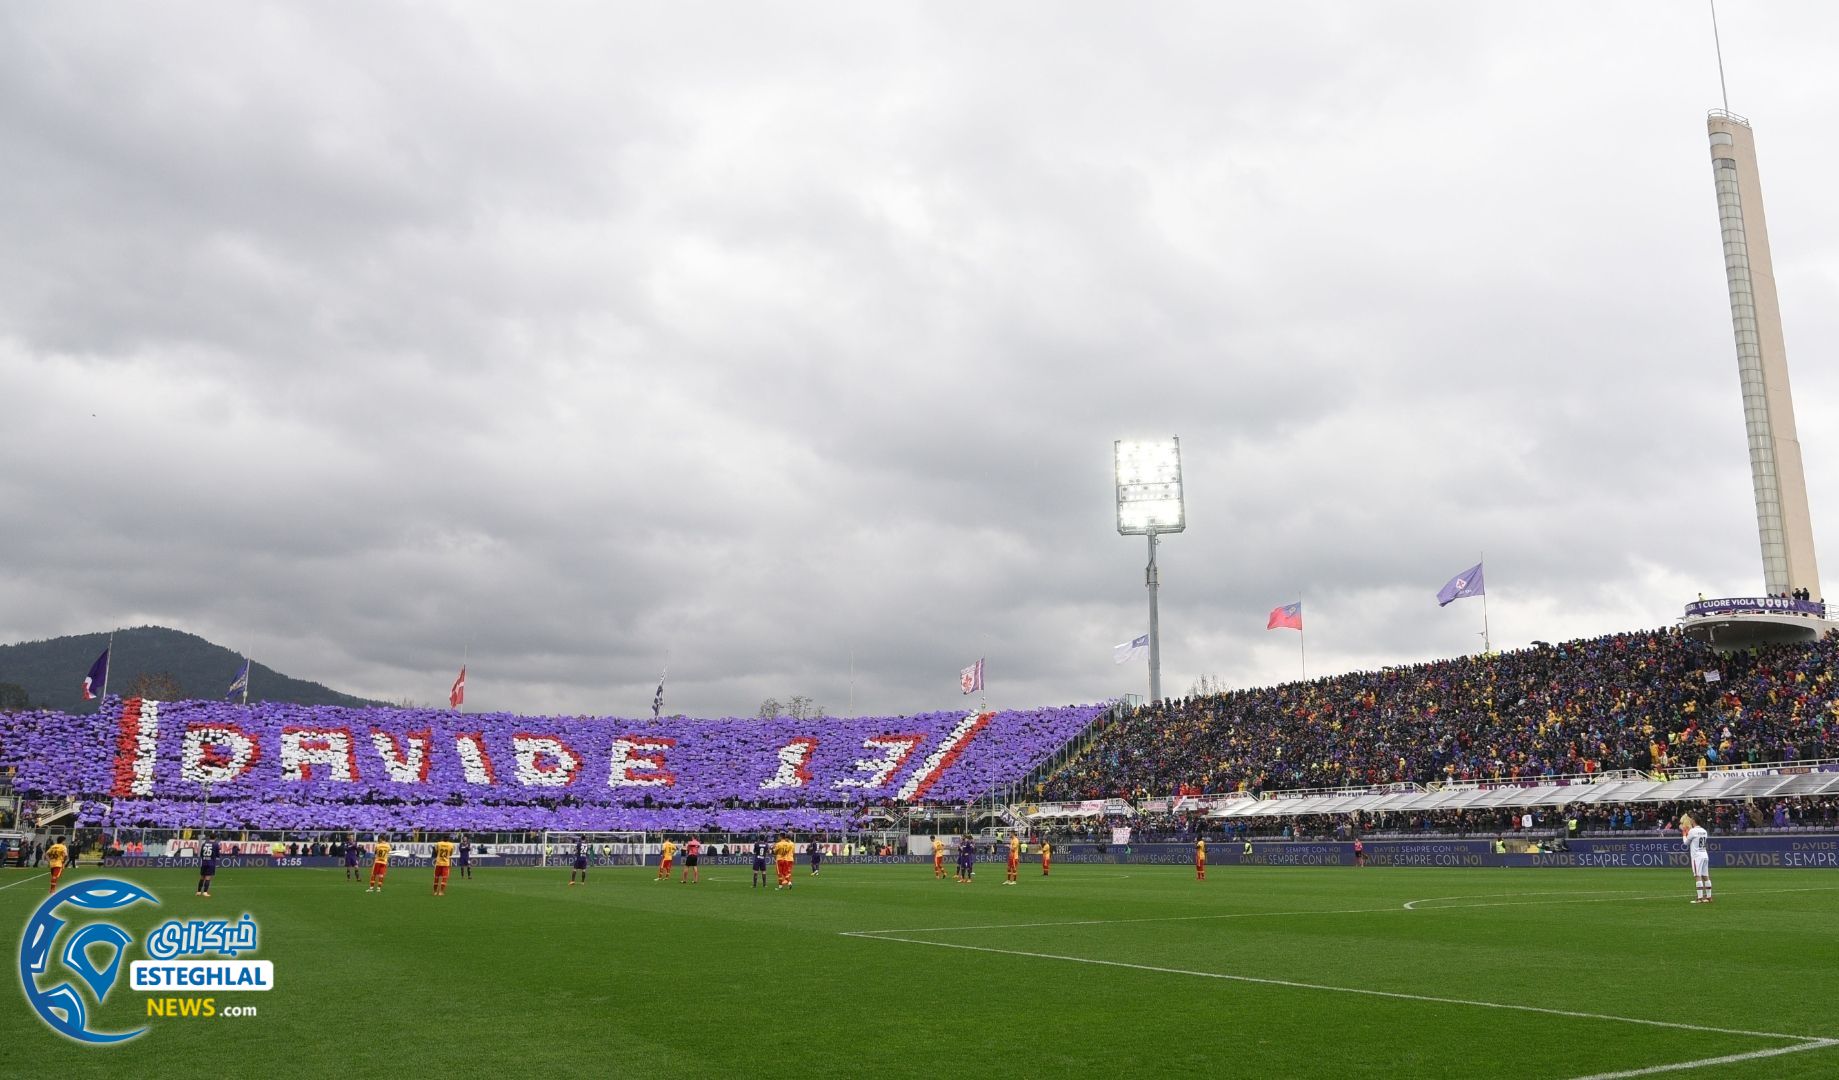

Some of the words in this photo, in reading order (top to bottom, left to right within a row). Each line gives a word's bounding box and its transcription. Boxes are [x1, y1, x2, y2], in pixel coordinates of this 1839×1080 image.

[1703, 599, 1730, 608] CUORE
[1732, 598, 1755, 606] VIOLA
[181, 721, 676, 788] DAVIDE
[759, 732, 928, 790] 13
[202, 846, 212, 856] 25
[1433, 845, 1450, 853] CON
[1592, 844, 1627, 852] DAVIDE
[1629, 844, 1668, 852] SEMPRE
[1792, 842, 1837, 850] DAVIDE
[104, 857, 152, 867] DAVIDE
[156, 857, 202, 868] SEMPR
[246, 858, 268, 866] NOI
[276, 858, 302, 866] 13:55
[718, 856, 753, 865] SEMPRE
[850, 856, 884, 864] SEMPRE
[887, 854, 906, 864] CON
[909, 855, 925, 864] NOI
[975, 854, 1006, 863] SEMPRE
[1067, 855, 1088, 863] SEMPRE
[1089, 855, 1102, 863] CON
[1126, 854, 1150, 863] DAVIDE
[1150, 855, 1176, 864] SEMPRE
[1178, 855, 1192, 864] CON
[1240, 854, 1267, 864] DAVIDE
[1268, 855, 1300, 864] SEMPRE
[1302, 854, 1322, 864] CON
[1325, 855, 1340, 864] NOI
[1394, 854, 1432, 864] SEMPRE
[1436, 854, 1460, 864] CON
[1464, 854, 1482, 864] NOI
[1532, 854, 1574, 865] DAVIDE
[1578, 854, 1628, 866] SEMPRE
[1632, 854, 1664, 866] CON
[1669, 854, 1690, 866] NO
[1725, 853, 1780, 866] DAVIDE
